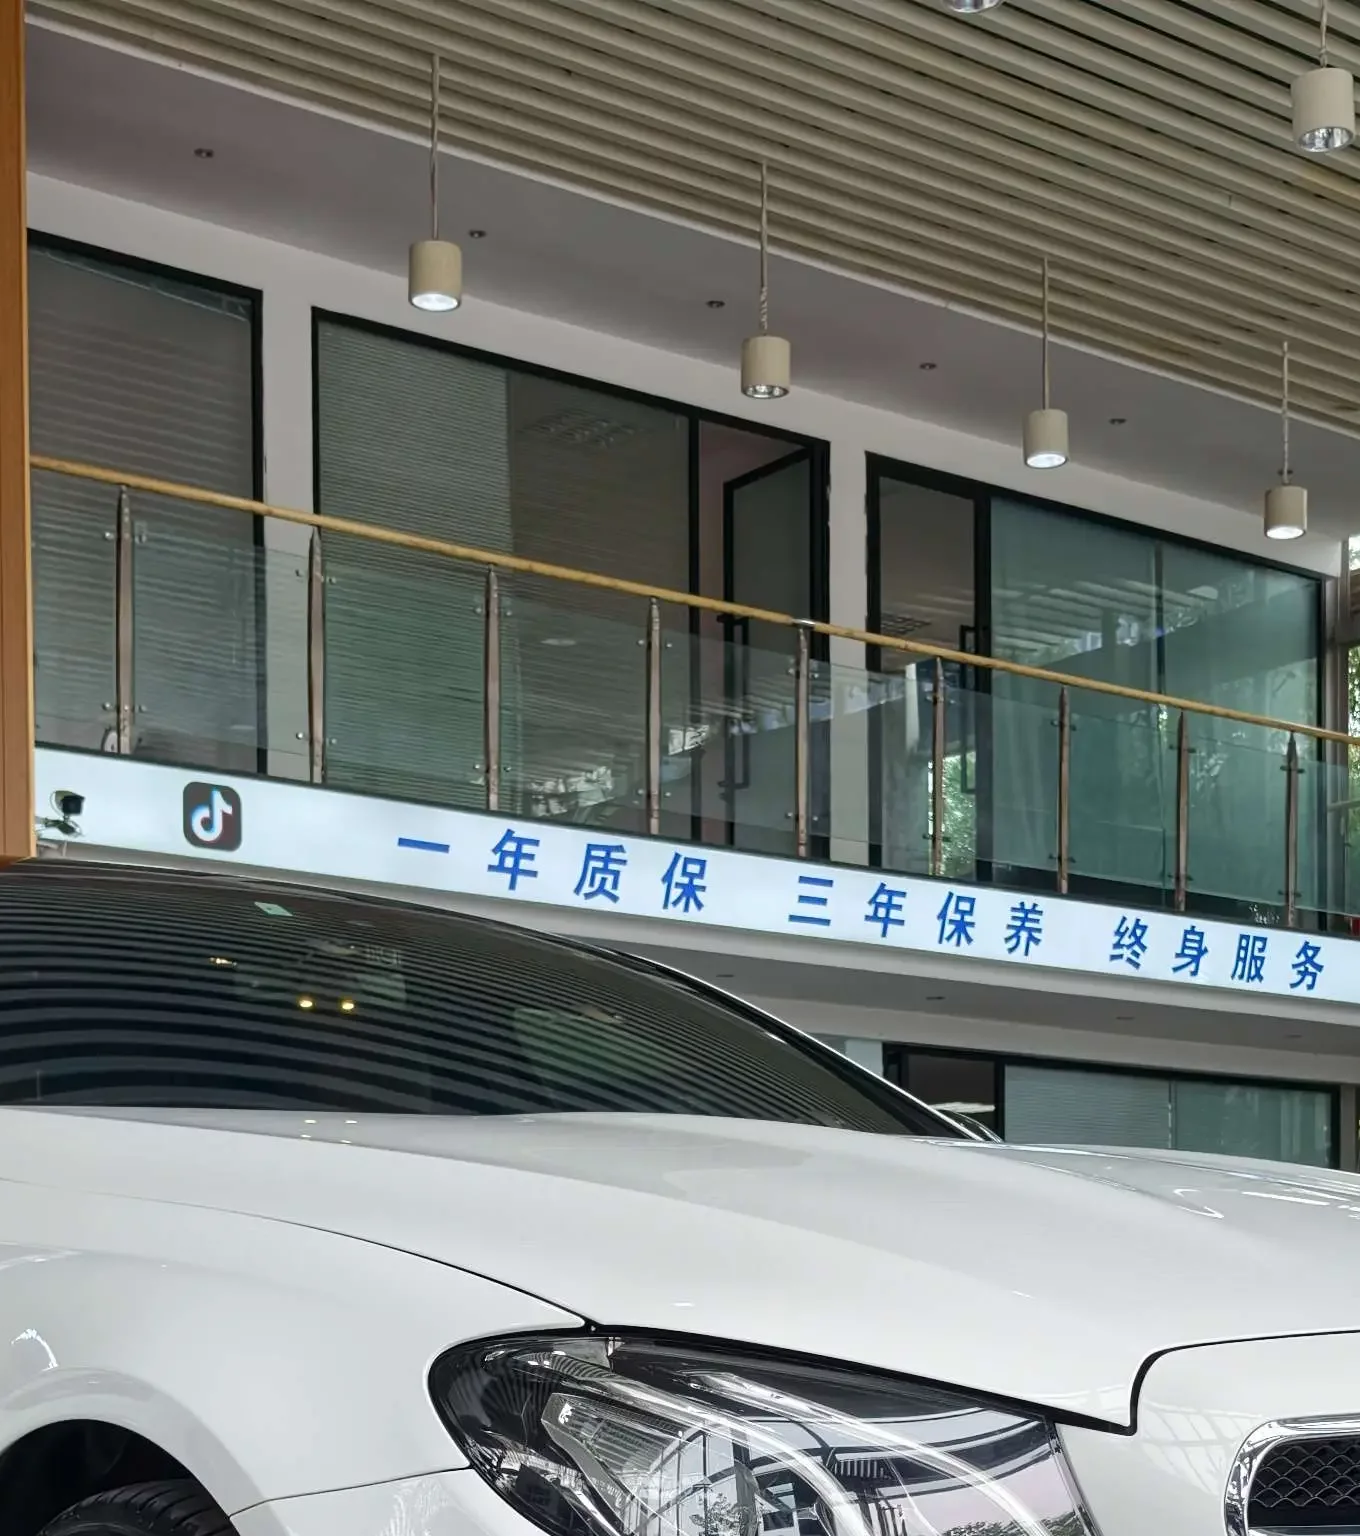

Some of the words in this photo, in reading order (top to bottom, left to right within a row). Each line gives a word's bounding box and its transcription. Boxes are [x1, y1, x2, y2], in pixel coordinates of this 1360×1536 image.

[397, 828, 707, 913] 一年质保
[788, 875, 1045, 958] 三年保养
[1109, 915, 1326, 991] 终身服务
